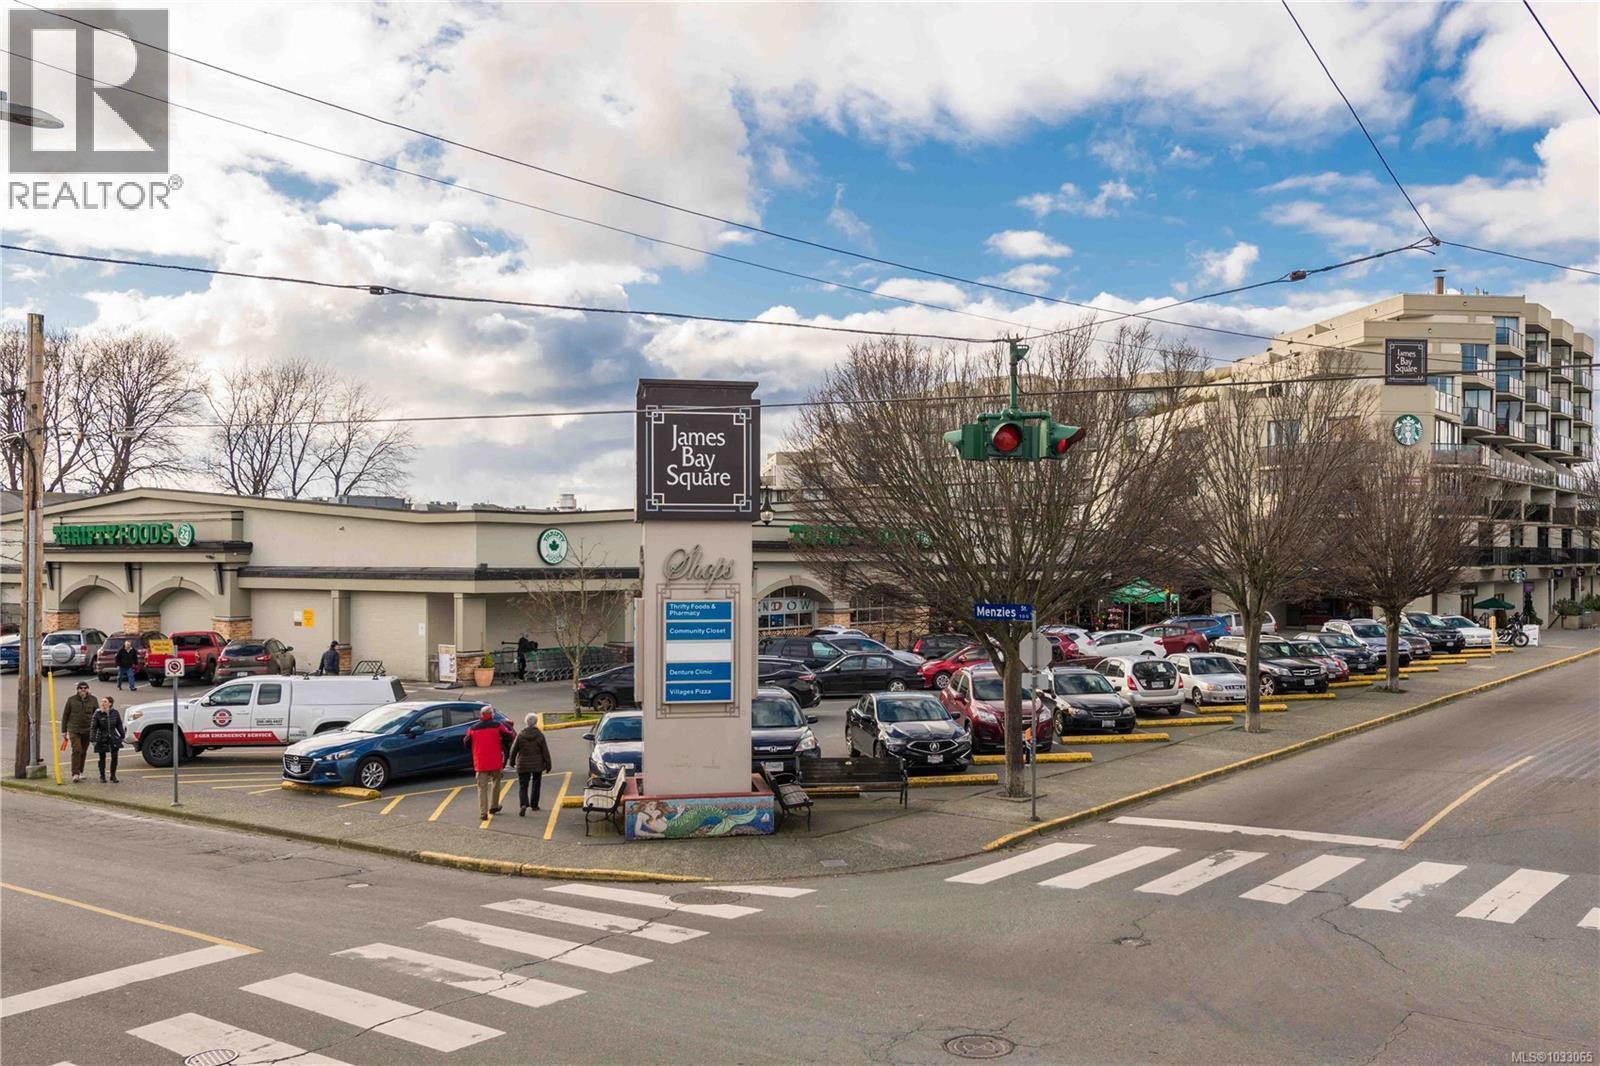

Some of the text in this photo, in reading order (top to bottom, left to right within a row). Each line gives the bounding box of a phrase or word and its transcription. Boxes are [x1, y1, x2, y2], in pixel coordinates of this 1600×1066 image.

[1397, 349, 1416, 358] James
[1400, 357, 1412, 368] Bay
[1395, 364, 1417, 374] Square
[671, 424, 726, 452] James
[682, 446, 716, 472] Bay
[666, 464, 731, 491] Square
[53, 522, 174, 546] THRIFTY FOODS
[180, 529, 190, 540] 24
[663, 544, 735, 594] Shops
[670, 603, 690, 611] Thrifty
[976, 606, 1017, 617] Menzies
[669, 688, 694, 696] Villages
